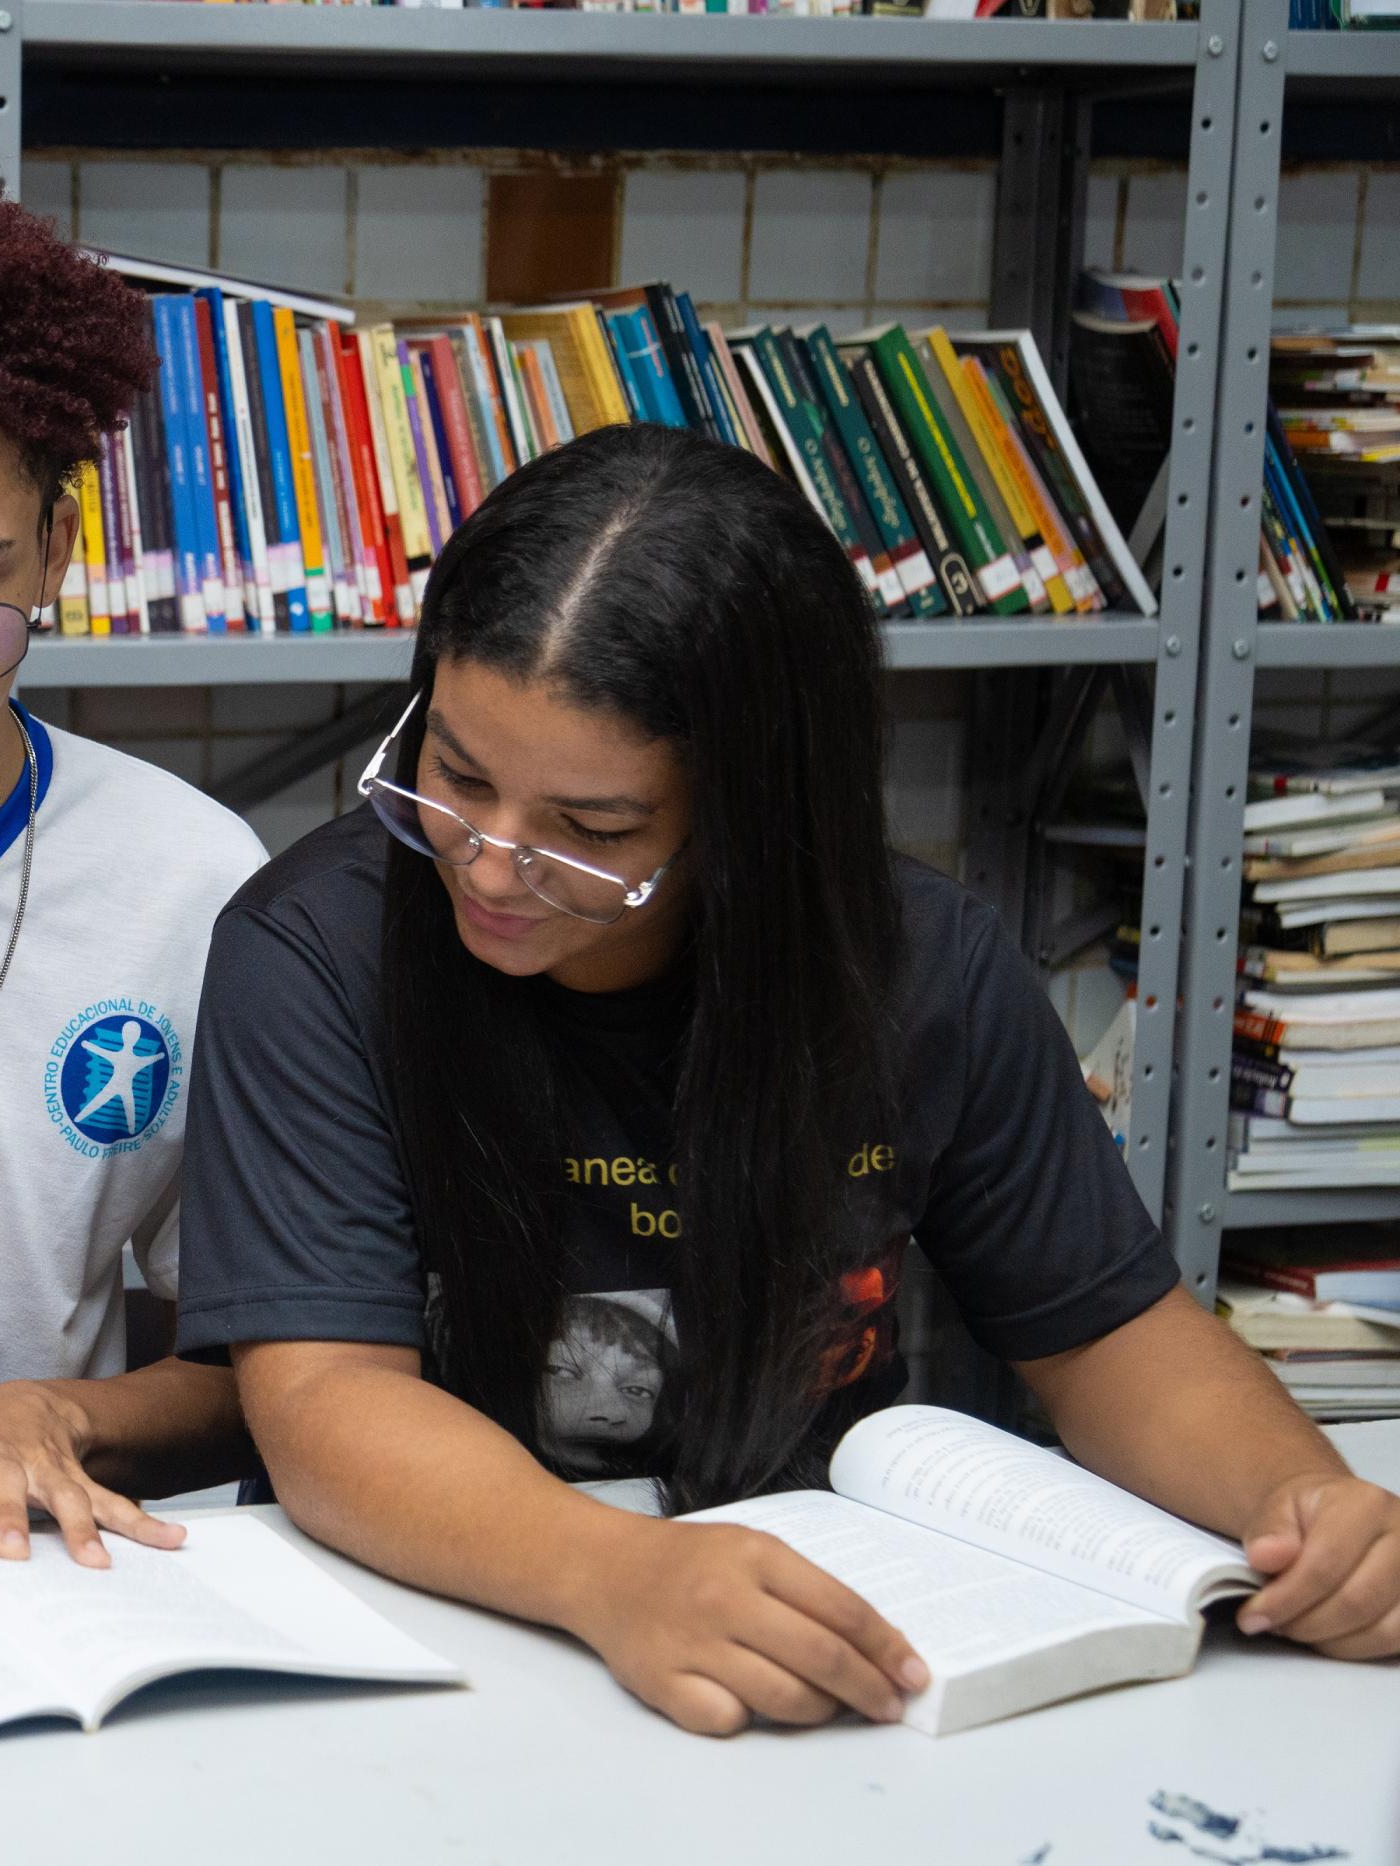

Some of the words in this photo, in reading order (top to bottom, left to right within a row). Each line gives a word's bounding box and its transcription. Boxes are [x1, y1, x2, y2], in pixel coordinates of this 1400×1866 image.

[51, 998, 134, 1058] EDUCACIONAL
[138, 1002, 157, 1020] DE
[155, 1013, 183, 1063] JOVENS
[171, 1066, 183, 1076] E
[44, 1061, 64, 1123] CENTRO
[143, 1079, 181, 1142] ADULTOS
[60, 1124, 99, 1159] PAULO
[848, 1142, 897, 1178] de
[629, 1202, 683, 1239] bo
